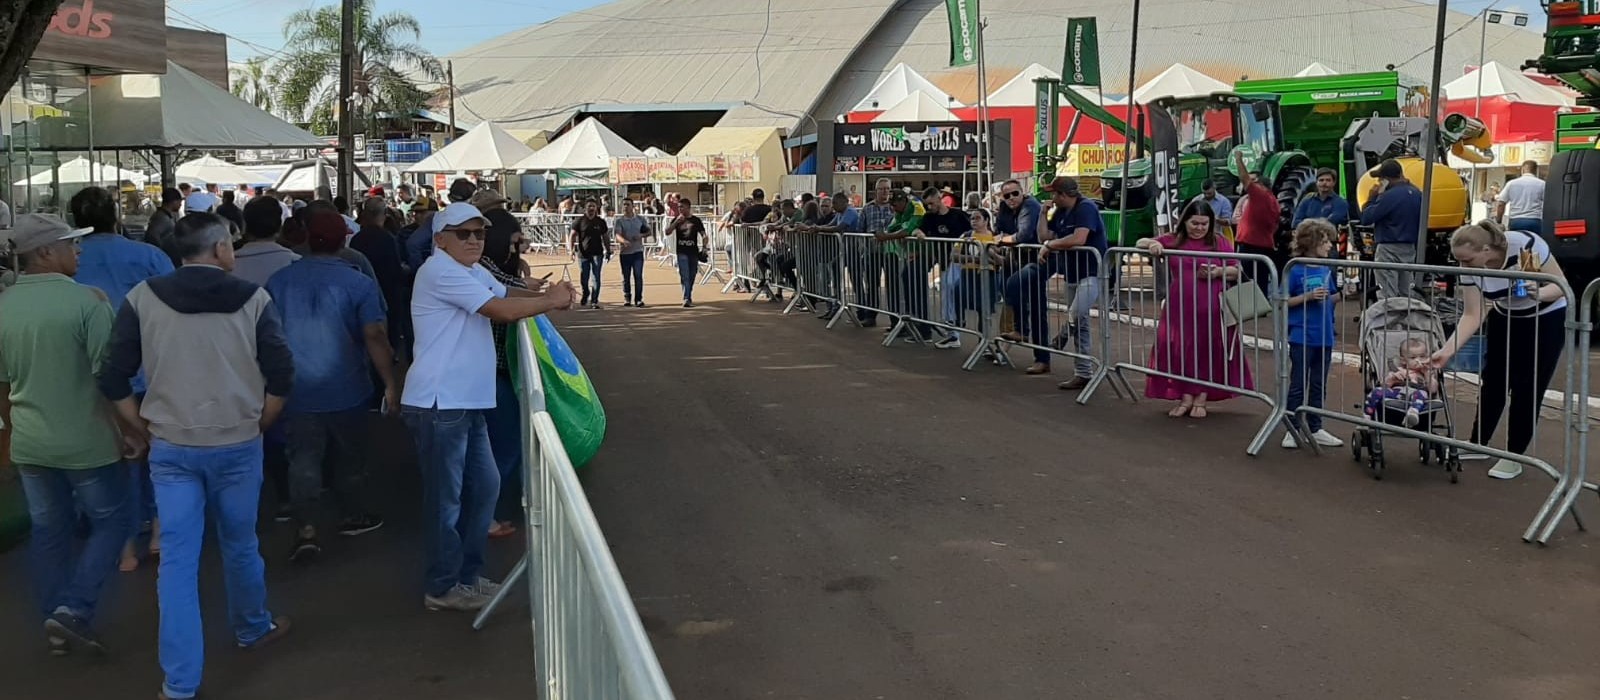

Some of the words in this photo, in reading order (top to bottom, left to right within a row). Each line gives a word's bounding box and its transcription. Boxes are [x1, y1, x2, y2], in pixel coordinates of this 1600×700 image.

[49, 0, 113, 38] ds
[1074, 24, 1083, 72] cocamar
[1040, 98, 1048, 131] SOLLUS
[871, 128, 905, 151] WORLD
[923, 127, 959, 150] BULLS
